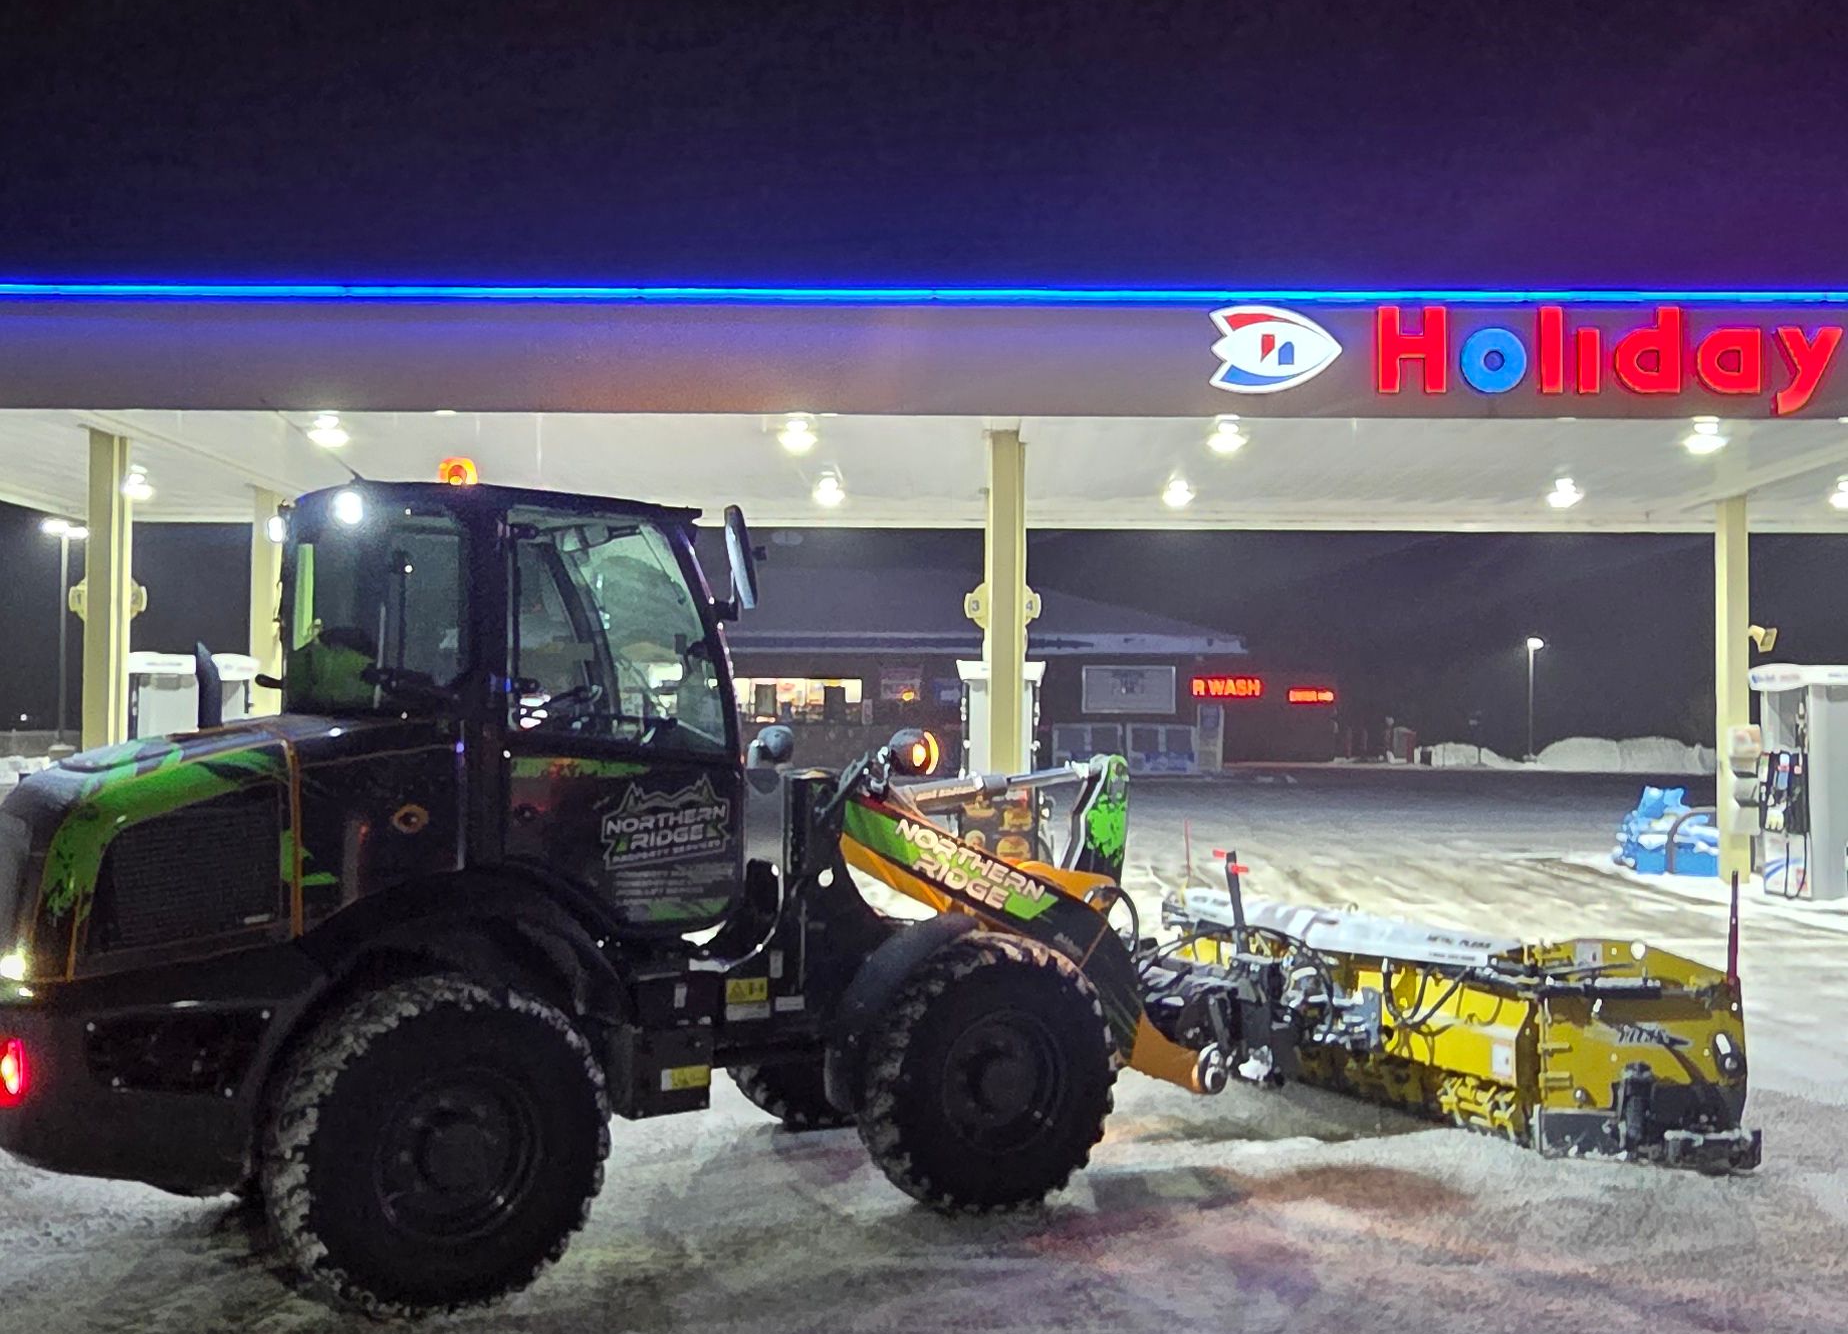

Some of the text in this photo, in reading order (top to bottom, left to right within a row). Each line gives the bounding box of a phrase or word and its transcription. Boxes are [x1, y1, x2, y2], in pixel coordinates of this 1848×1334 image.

[1377, 305, 1844, 415] Holiday
[971, 599, 980, 612] 3
[1026, 599, 1033, 611] 4
[1208, 678, 1260, 696] WASH
[606, 805, 726, 835] NORTHERN
[631, 824, 704, 850] RIDGE
[895, 819, 1046, 900] NORTHERN
[911, 850, 1009, 910] RIDGE
